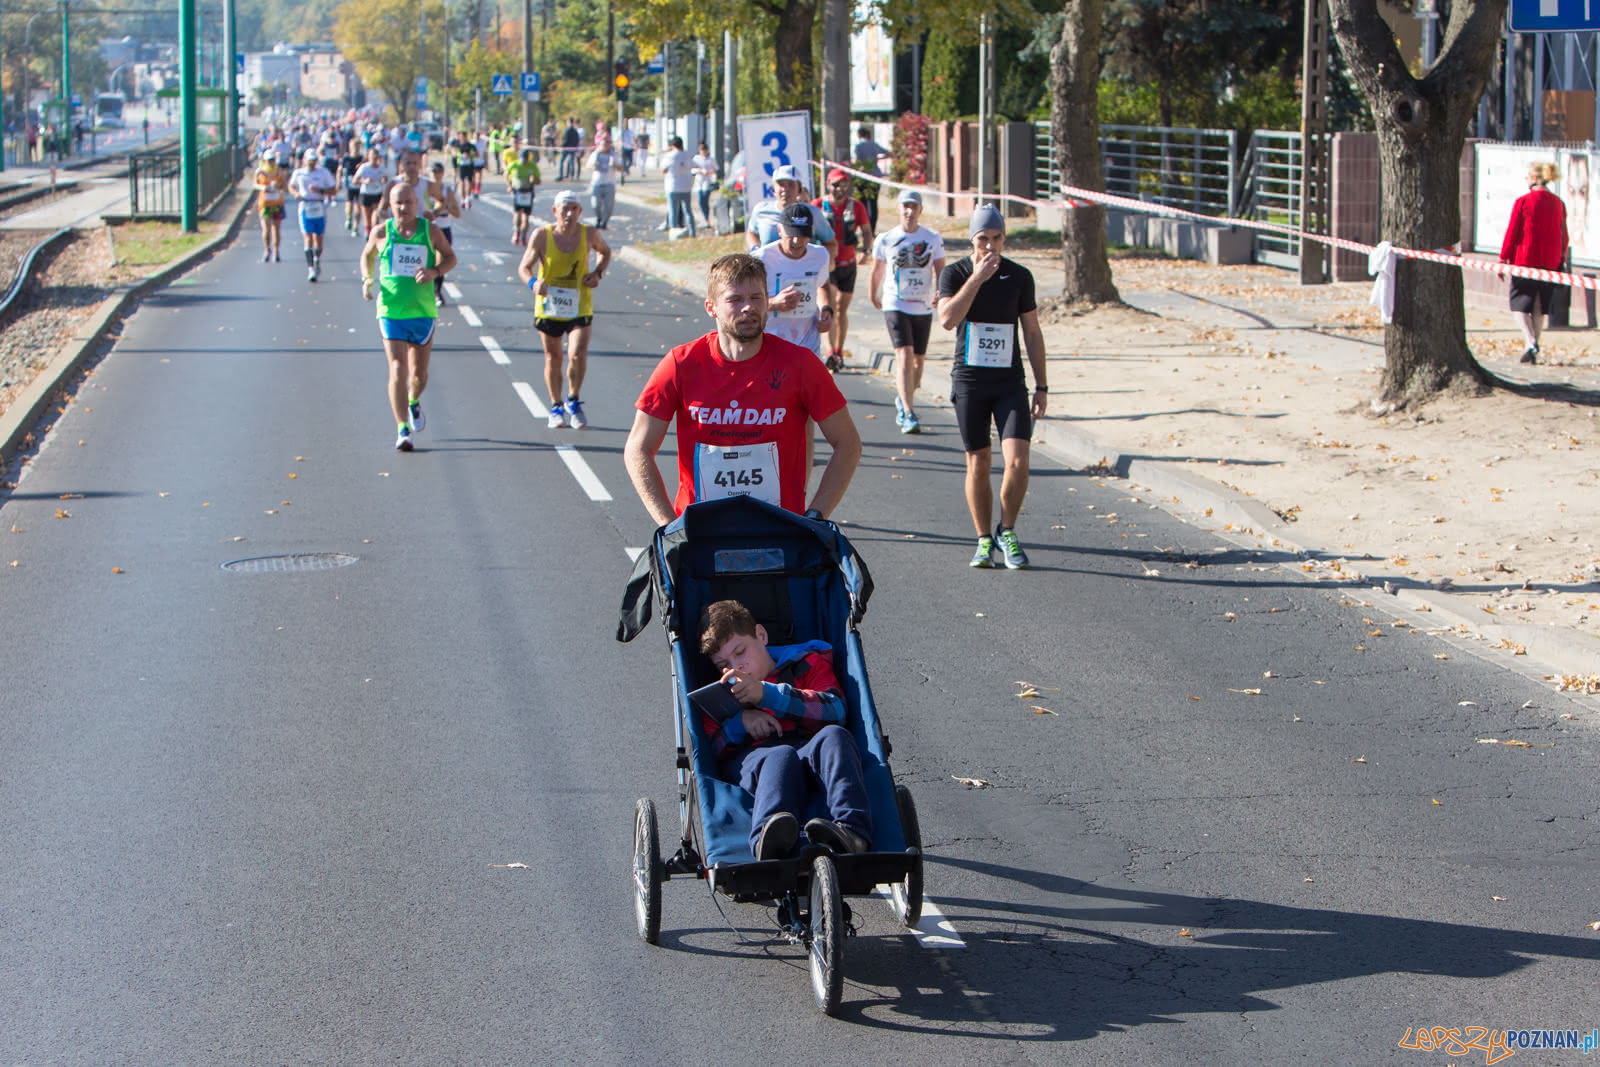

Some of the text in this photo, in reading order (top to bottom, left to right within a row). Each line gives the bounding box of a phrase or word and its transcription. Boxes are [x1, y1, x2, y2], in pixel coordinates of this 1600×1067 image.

[525, 74, 536, 88] P
[761, 131, 791, 177] 3
[762, 183, 775, 199] k
[399, 255, 422, 265] 2866
[552, 296, 573, 306] 3941
[979, 338, 1005, 350] 5291
[688, 405, 786, 425] TEAM DAR
[714, 468, 763, 488] 4145
